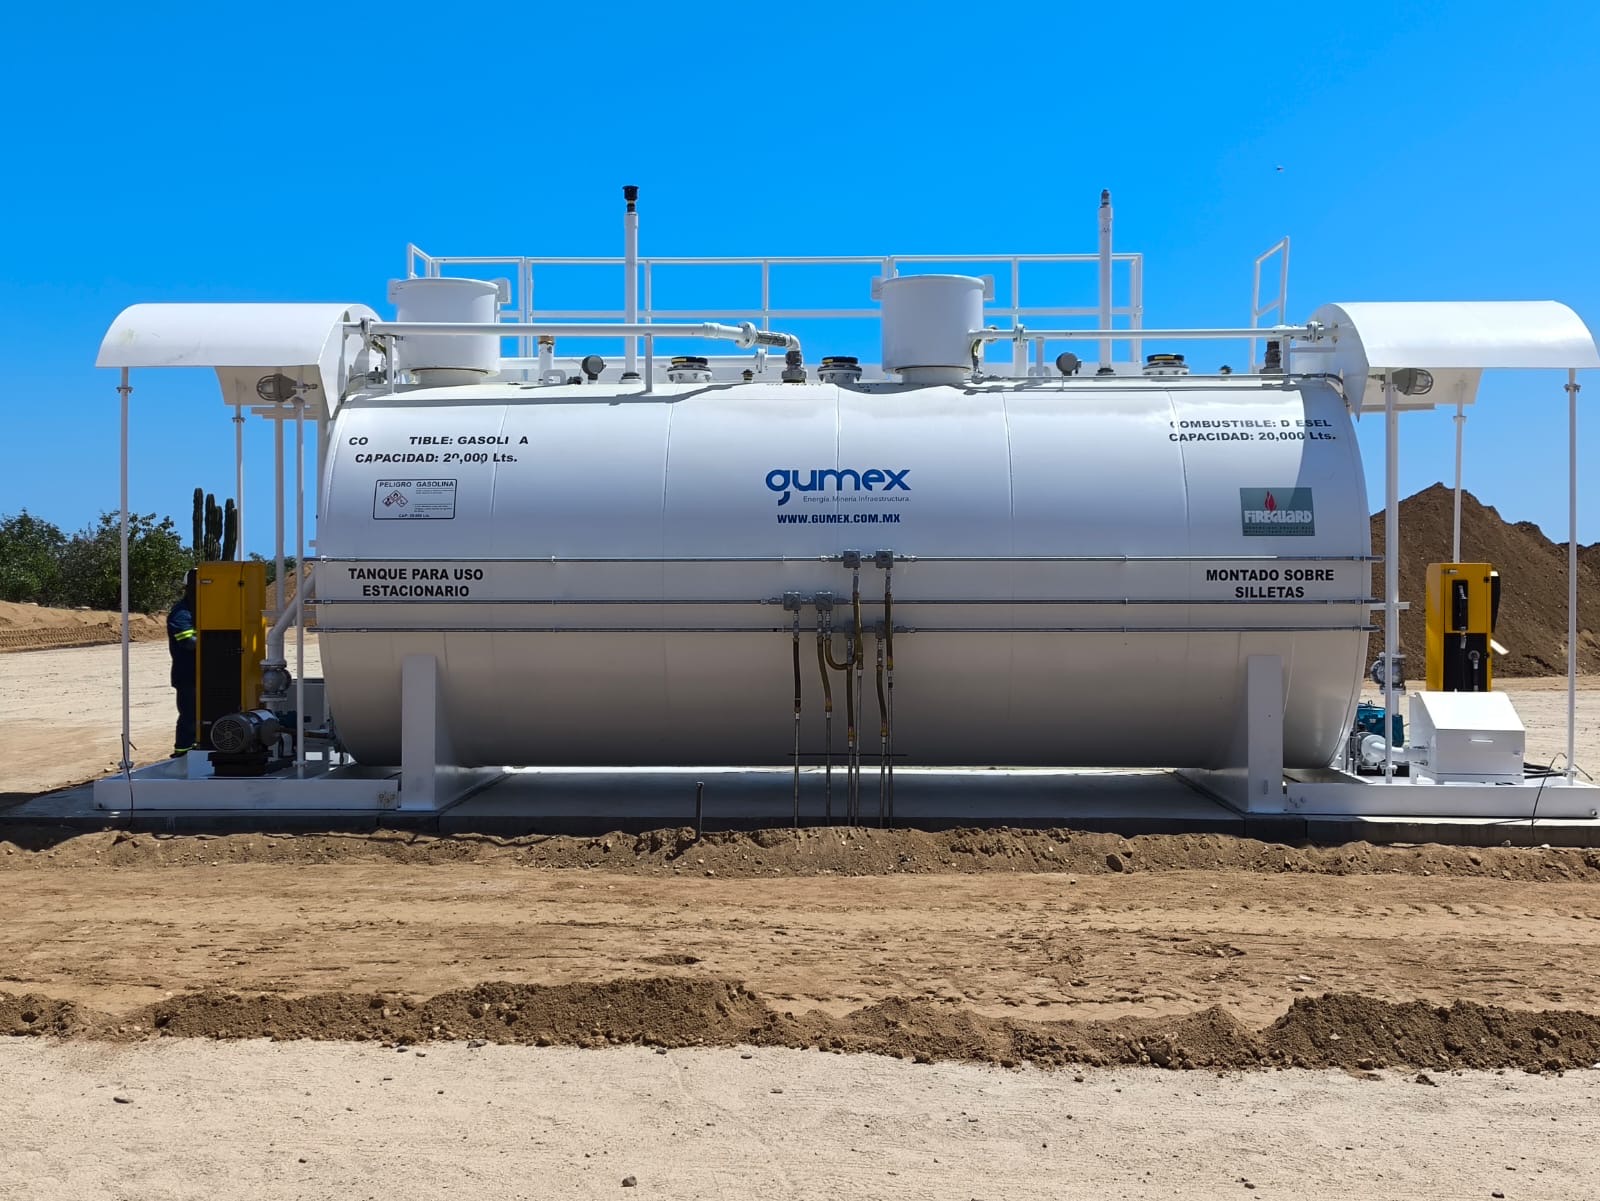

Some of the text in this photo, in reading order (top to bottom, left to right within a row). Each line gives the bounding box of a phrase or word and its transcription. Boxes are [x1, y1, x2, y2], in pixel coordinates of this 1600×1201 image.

[349, 436, 528, 445] COTIBLE: GASOLIA
[1169, 431, 1336, 441] CAPACIDAD: 20,000 Lts.
[355, 453, 439, 463] CAPACIDAD:
[493, 453, 518, 462] Lts.
[765, 469, 912, 506] gumex
[777, 514, 900, 523] WWW.GUMEX.COM.MX
[348, 568, 484, 580] TANQUE PARA USO
[1206, 569, 1334, 581] MONTADO SOBRE
[363, 585, 469, 597] ESTACIONARIO
[1235, 586, 1305, 598] SILLETAS
